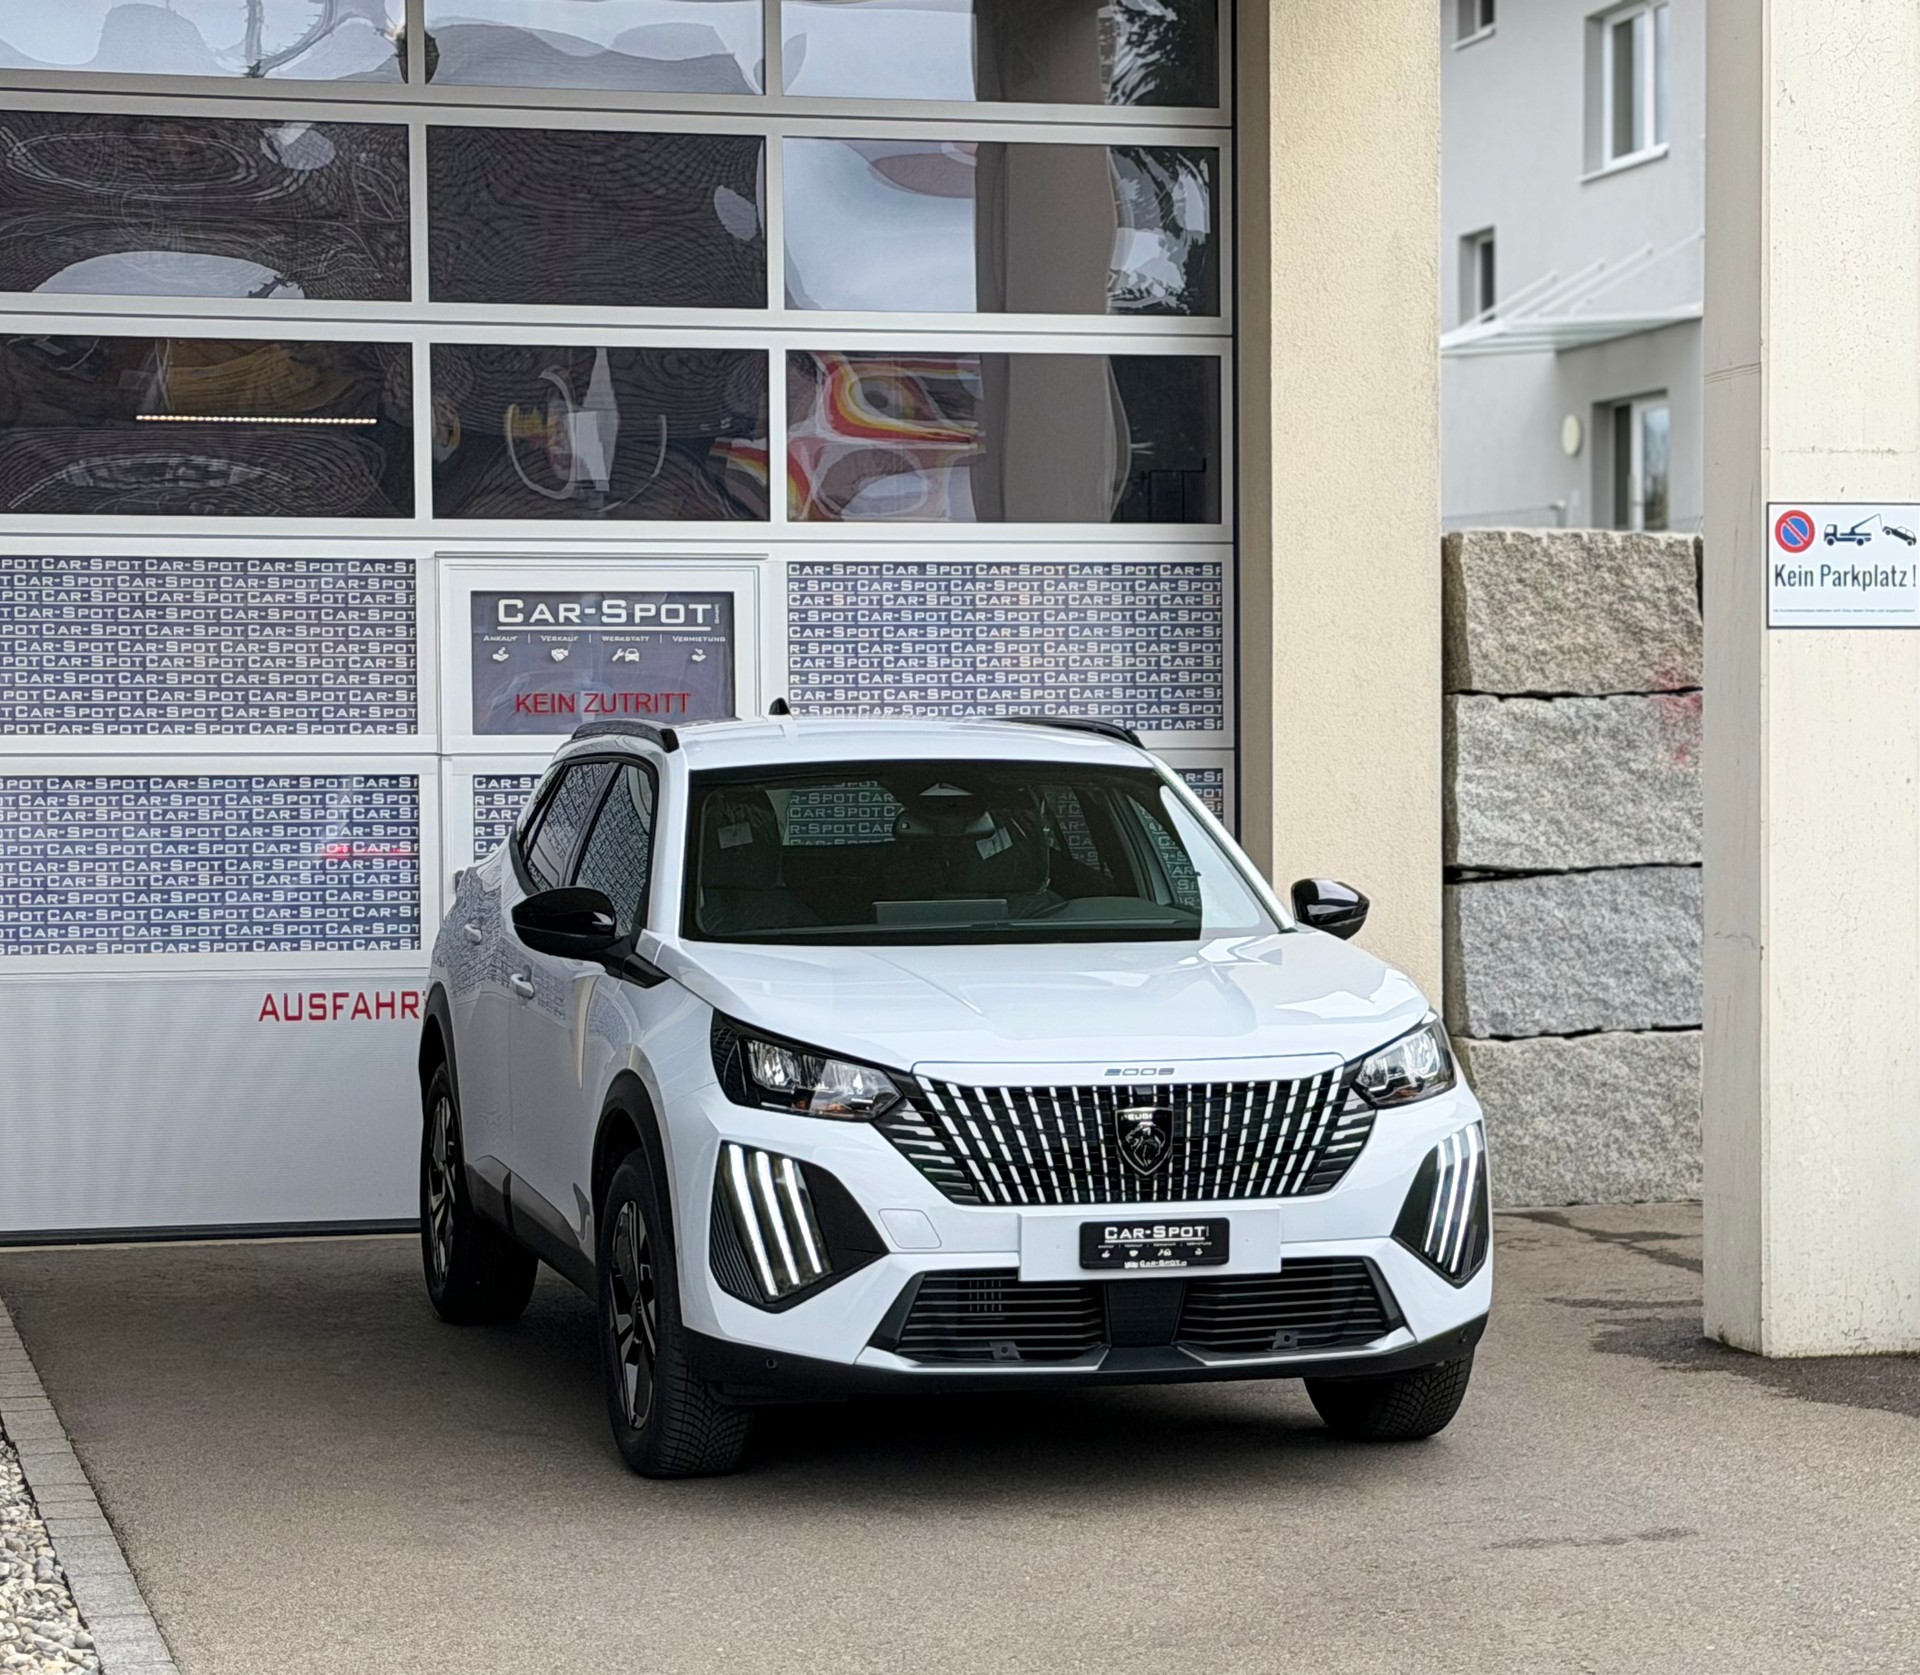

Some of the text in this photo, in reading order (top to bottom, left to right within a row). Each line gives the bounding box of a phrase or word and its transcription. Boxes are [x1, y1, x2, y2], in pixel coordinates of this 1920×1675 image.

[1774, 564, 1814, 588] Kein
[1820, 564, 1908, 592] Parkplatz
[515, 692, 692, 714] KEIN ZUTRITT
[258, 991, 426, 1022] AUSFAHR
